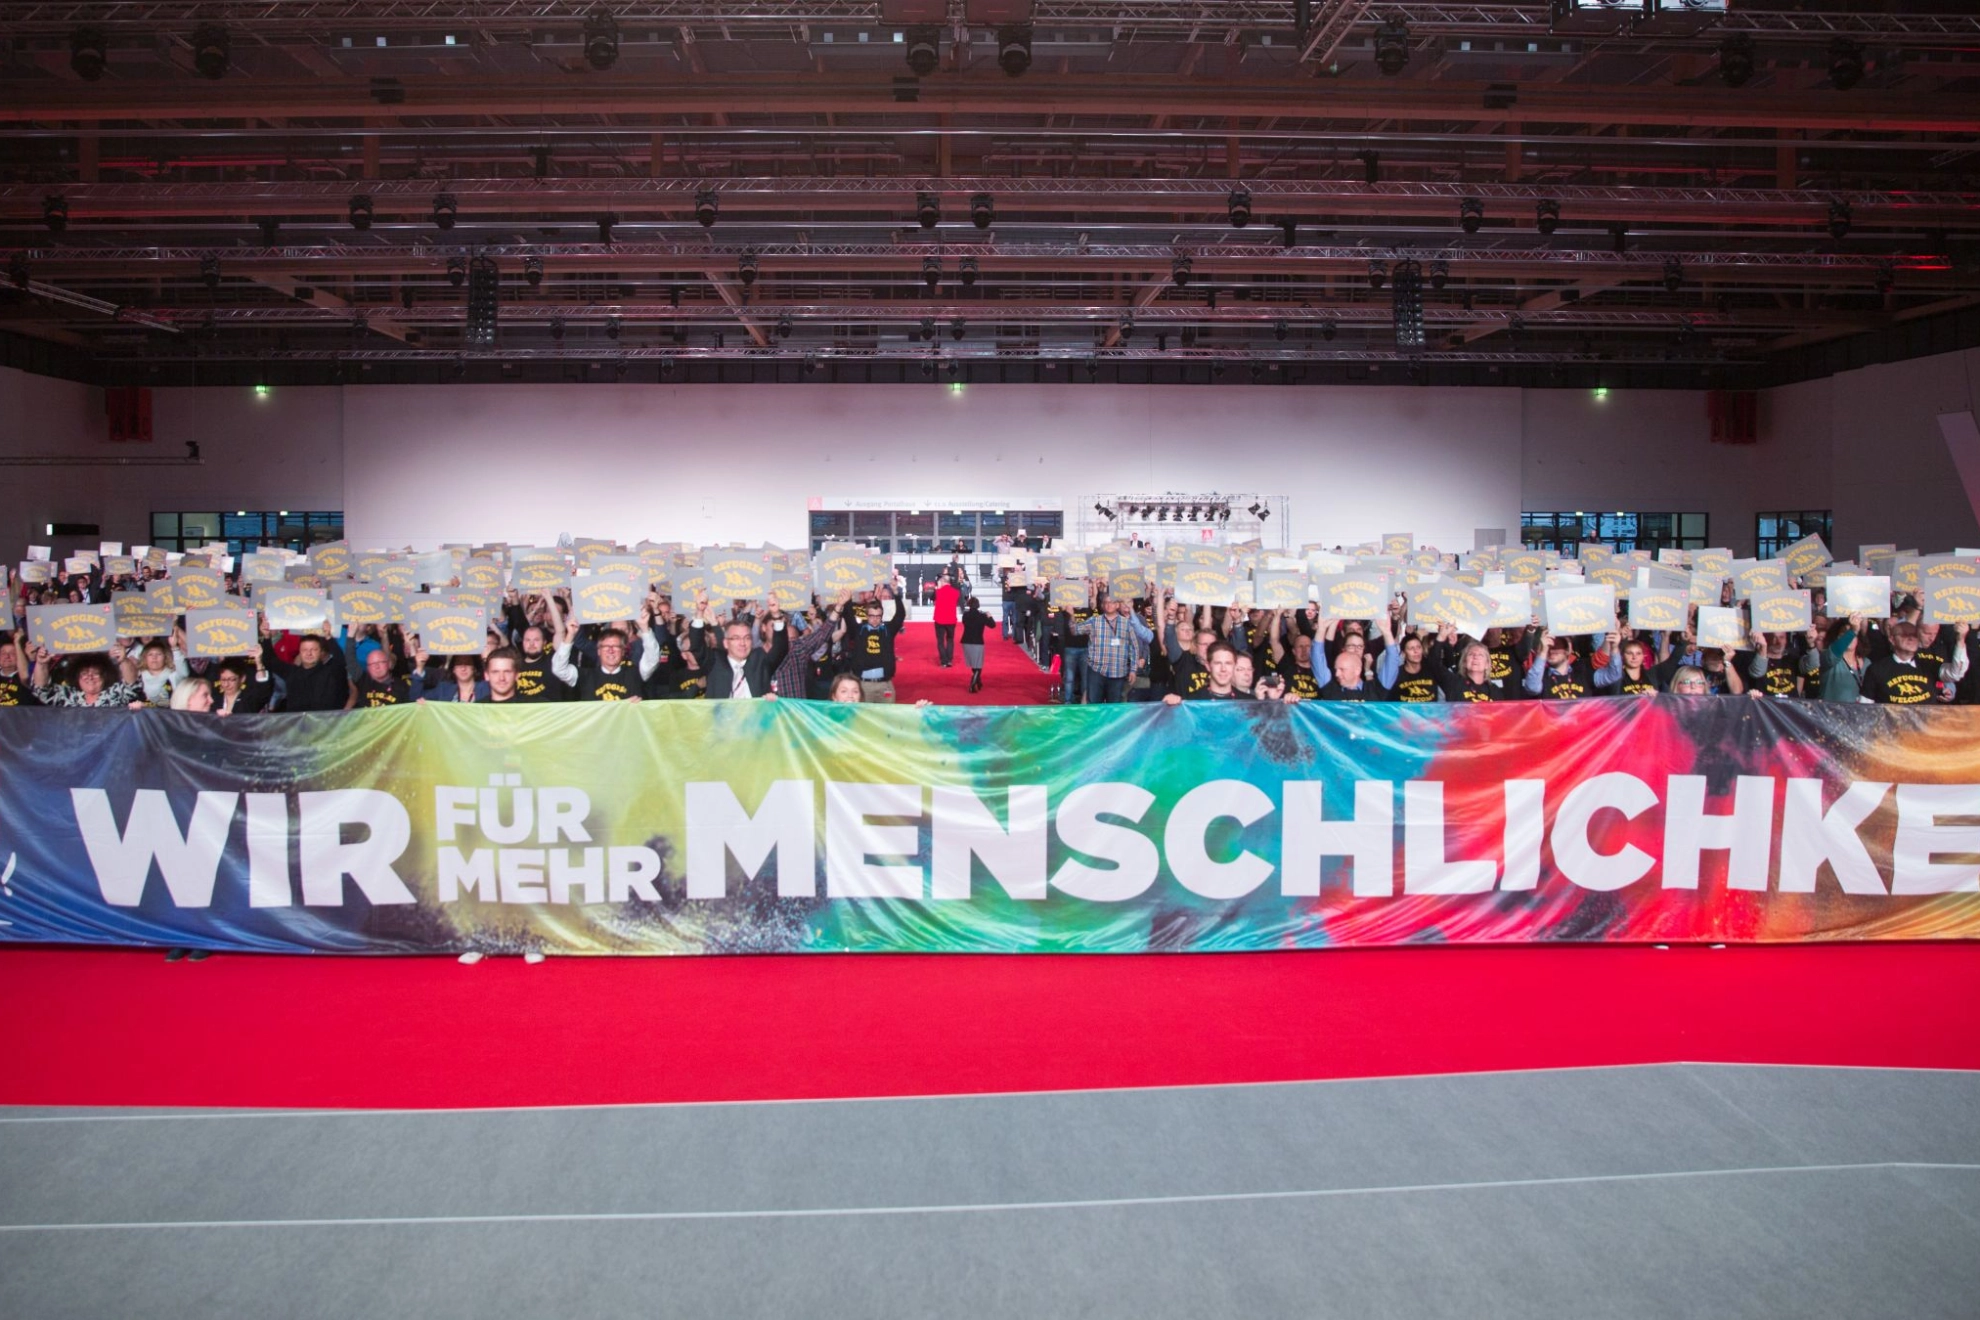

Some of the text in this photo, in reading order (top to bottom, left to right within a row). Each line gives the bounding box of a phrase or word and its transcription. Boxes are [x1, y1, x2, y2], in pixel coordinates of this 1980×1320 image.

[856, 500, 882, 509] Ausgang
[315, 547, 347, 561] REFUGEES
[1786, 543, 1819, 562] REFUGEES
[712, 561, 765, 574] REFUGEES
[824, 557, 867, 569] REFUGEES
[1511, 556, 1541, 567] REFUGEES
[1790, 555, 1825, 574] WELCOME
[317, 563, 349, 576] WELCOME
[1591, 568, 1631, 579] REFUGEES
[1741, 566, 1780, 580] REFUGEES
[1927, 562, 1976, 575] REFUGEES
[177, 575, 219, 587] REFUGEES
[1184, 571, 1230, 584] REFUGEES
[580, 582, 632, 597] REFUGEES
[713, 586, 763, 598] WELCOME
[1329, 582, 1380, 594] REFUGEES
[177, 597, 218, 608] WELCOME
[273, 596, 319, 607] REFUGEES
[341, 590, 384, 602] REFUGEES
[1442, 588, 1487, 617] REFUGEES
[1556, 595, 1607, 608] REFUGEES
[1637, 595, 1683, 608] REFUGEES
[1759, 594, 1804, 609] REFUGEES
[409, 601, 448, 611] REFUGEES
[582, 606, 633, 618] WELCOME
[1329, 605, 1380, 617] WELCOME
[51, 614, 106, 629] REFUGEES
[342, 612, 386, 623] WELCOME
[427, 616, 478, 628] REFUGEES
[1637, 617, 1682, 629] WELCOME
[1761, 617, 1805, 630] WELCOME
[194, 619, 249, 632] REFUGEES
[1558, 619, 1608, 631] WELCOME
[53, 638, 108, 651] WELCOME
[196, 642, 249, 655] WELCOME
[428, 641, 479, 652] WELCOME
[1399, 679, 1434, 689] REFUGEES
[1887, 675, 1928, 688] REFUGEES
[1400, 693, 1437, 704] WELCOME
[1889, 691, 1930, 704] WELCOME
[434, 773, 592, 846] FÜR
[685, 770, 1980, 903] MENSCHLICHKE
[70, 787, 418, 908] WIR
[436, 846, 662, 904] MEHR
